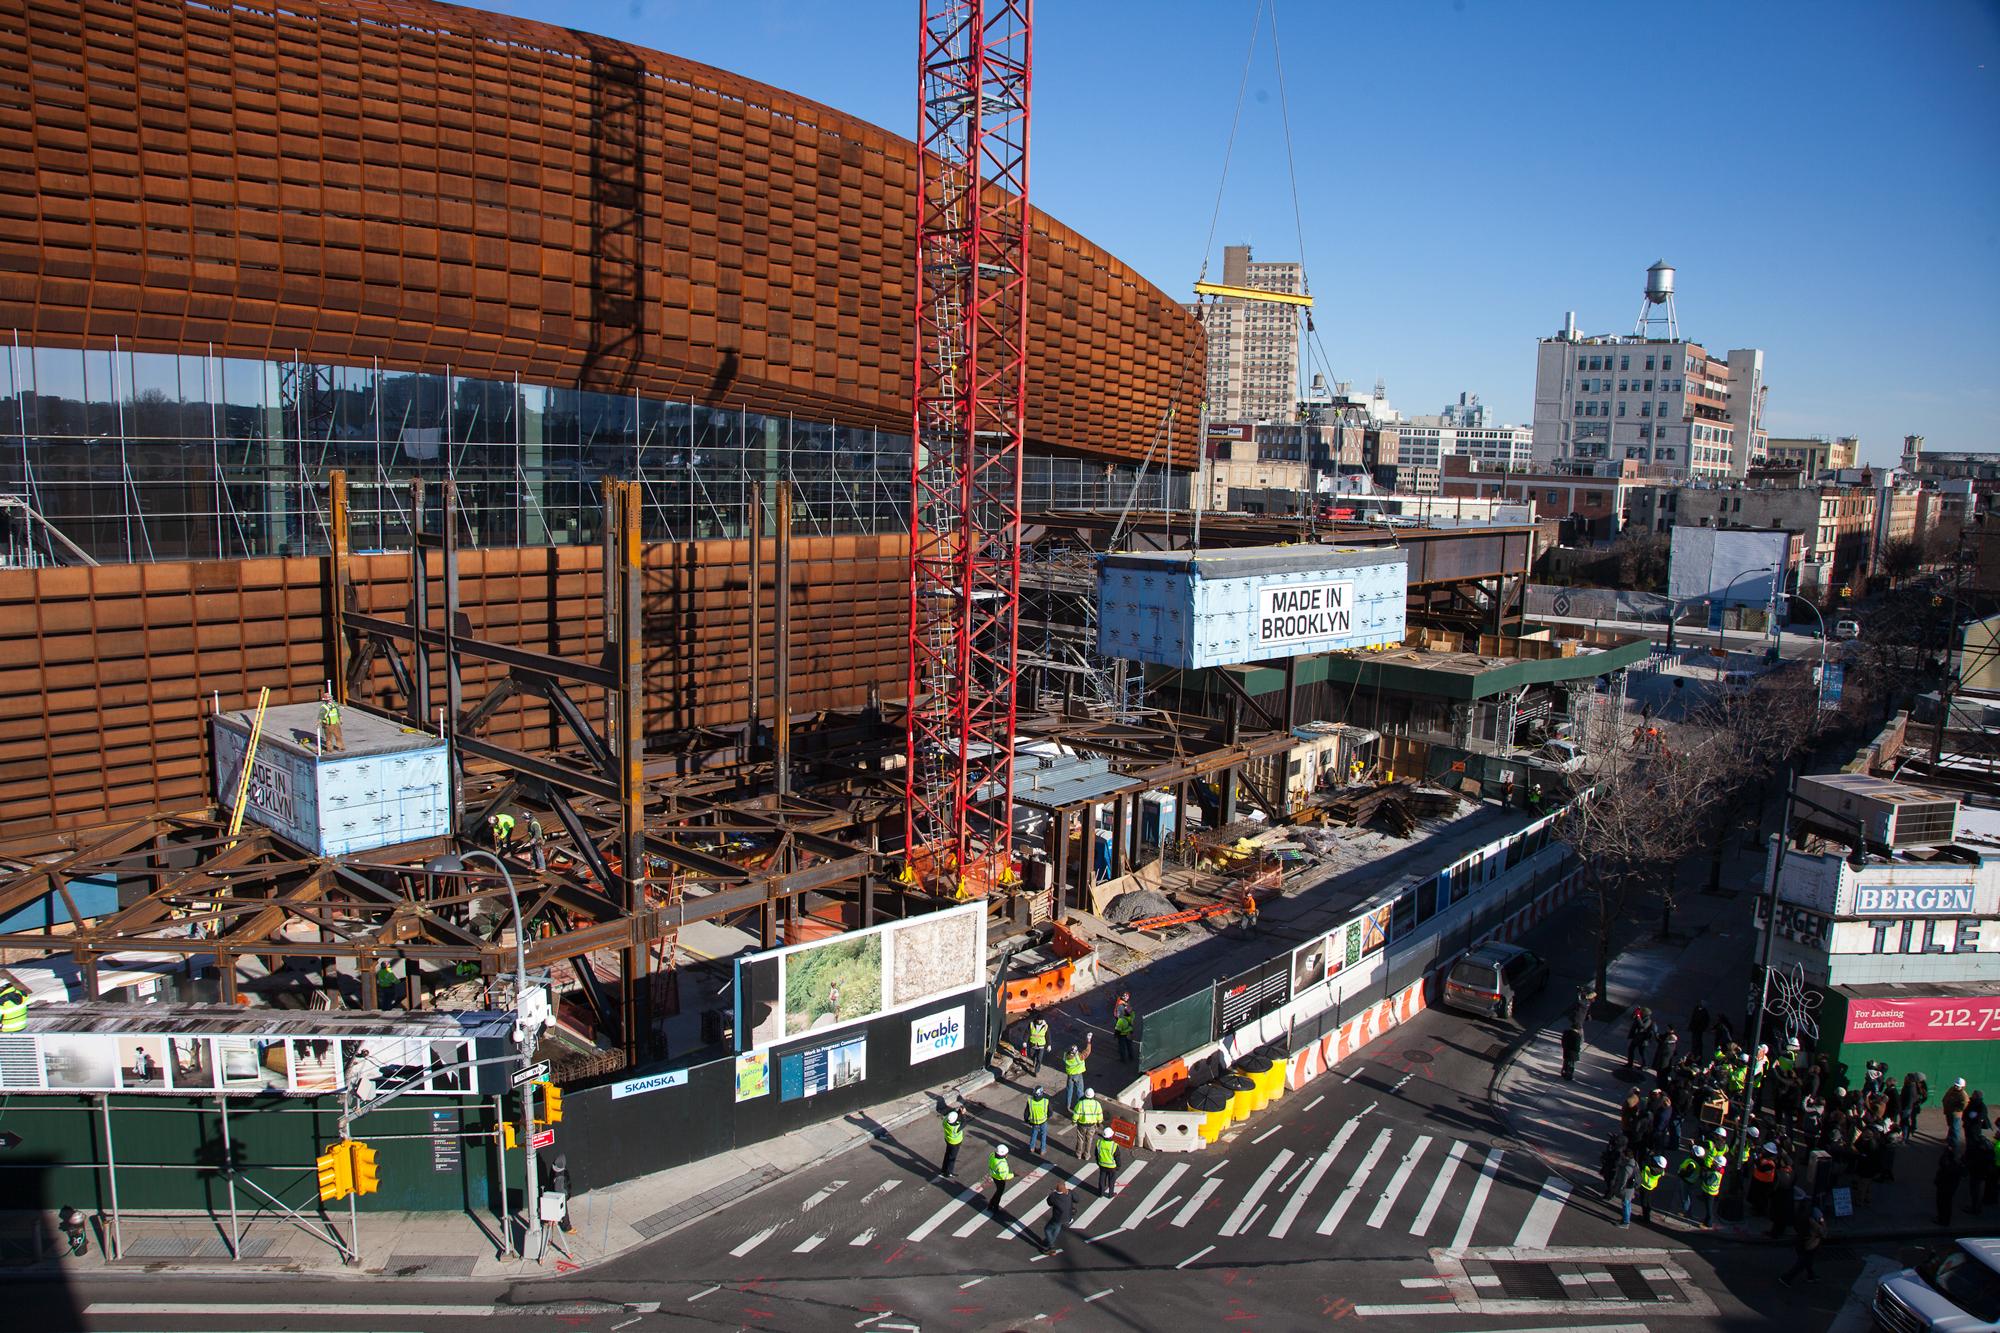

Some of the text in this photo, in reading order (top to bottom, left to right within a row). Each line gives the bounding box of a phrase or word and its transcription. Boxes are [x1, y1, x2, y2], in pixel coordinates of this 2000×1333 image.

[1272, 587, 1341, 613] MADE IN
[1262, 610, 1350, 639] BROOKLYN
[250, 761, 286, 795] ADE IN
[247, 781, 292, 820] ROOKLYN
[1860, 888, 1973, 910] BERGEN
[1868, 919, 1981, 953] TILE
[1853, 1020, 1905, 1029] Information
[1855, 1010, 1870, 1018] For
[1871, 1009, 1905, 1019] Leasing
[916, 1016, 959, 1044] livable
[934, 1033, 958, 1048] city
[517, 1066, 544, 1082] ONE WAY
[625, 1075, 676, 1093] SKANSKA
